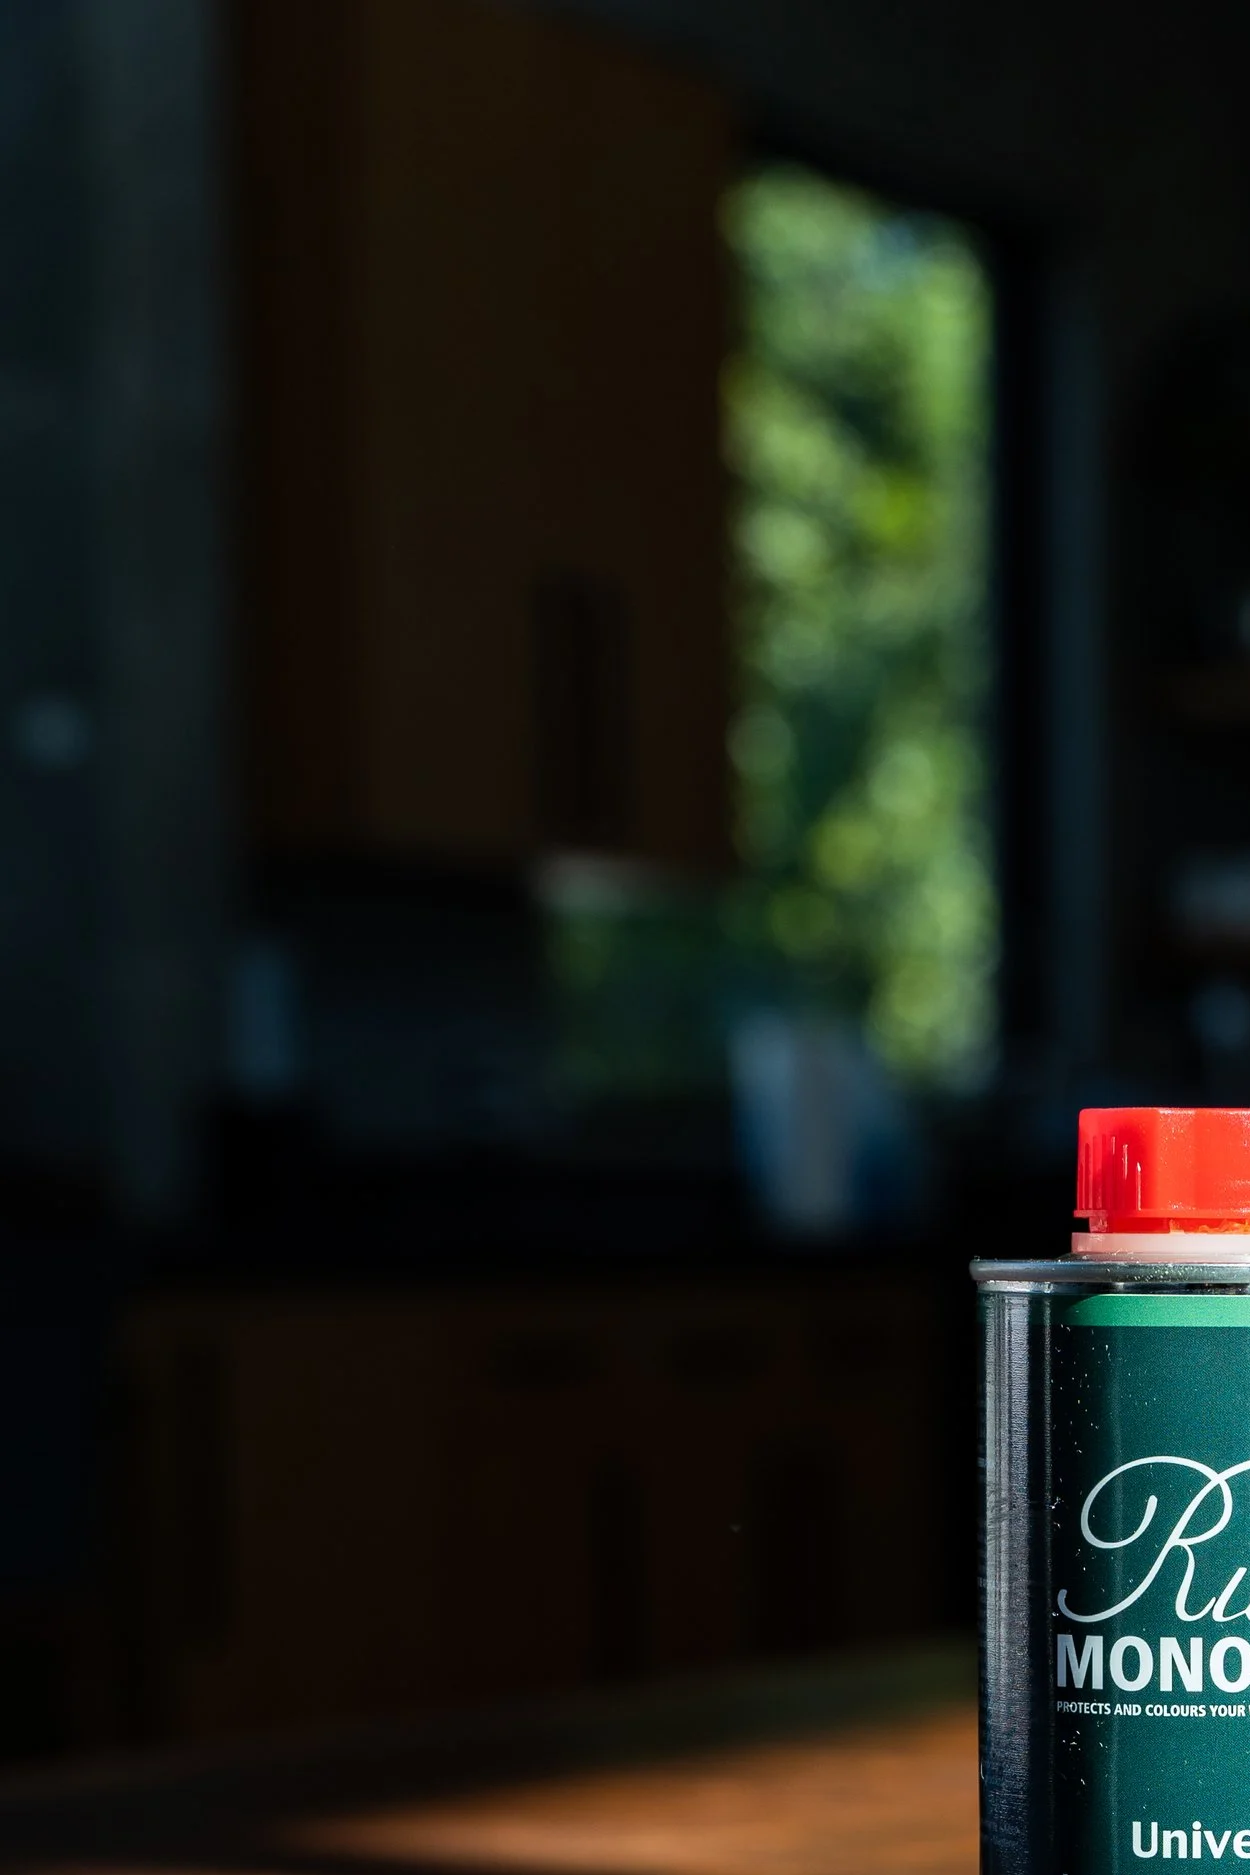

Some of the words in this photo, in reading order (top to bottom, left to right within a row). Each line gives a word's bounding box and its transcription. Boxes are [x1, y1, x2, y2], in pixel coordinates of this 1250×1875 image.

[1056, 1701, 1111, 1716] PROTECTS
[1114, 1703, 1142, 1717] AND
[1145, 1704, 1206, 1718] COLOURS
[1210, 1704, 1246, 1718] YOUR
